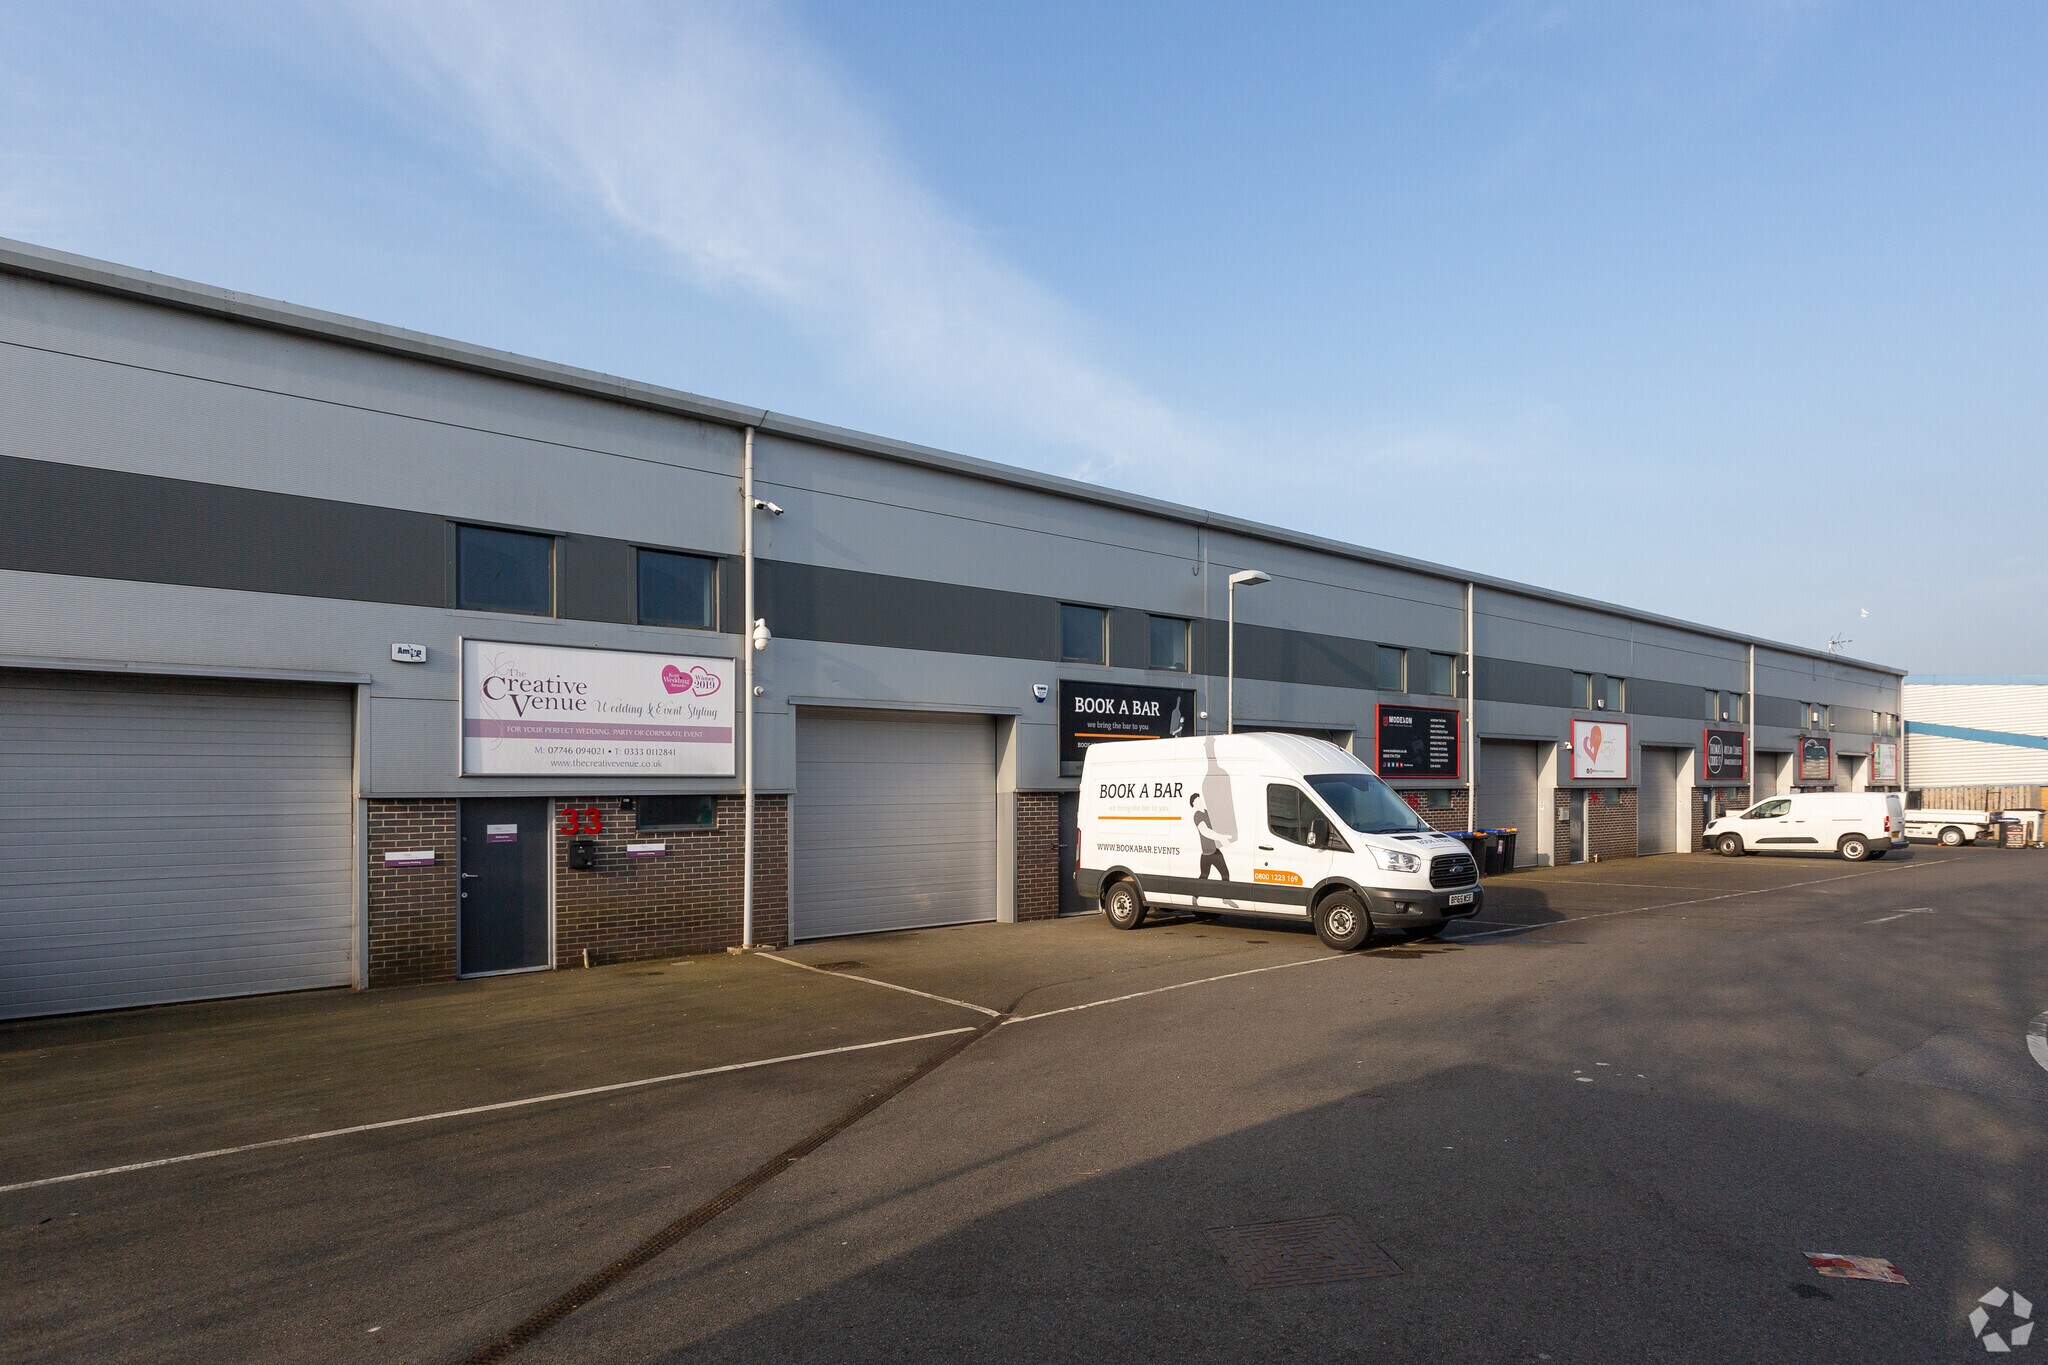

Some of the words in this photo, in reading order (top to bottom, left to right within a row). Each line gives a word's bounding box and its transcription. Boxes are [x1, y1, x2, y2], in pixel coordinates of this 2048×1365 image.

[508, 668, 527, 678] The
[482, 675, 588, 701] Creative
[694, 680, 715, 690] 2019
[508, 694, 587, 718] Venue
[592, 698, 643, 718] Wedding
[655, 702, 682, 716] Event
[687, 703, 718, 720] Styling
[1074, 696, 1115, 714] BOOK
[1118, 699, 1130, 715] A
[1132, 700, 1160, 717] BAR
[506, 725, 522, 733] FOR
[523, 726, 543, 734] YOUR
[613, 728, 633, 736] PARTY
[1096, 721, 1112, 731] bring
[1112, 721, 1122, 730] the
[1122, 722, 1132, 730] bar
[534, 746, 546, 754] M:
[547, 746, 574, 755] 07746
[575, 747, 606, 755] 094021
[624, 748, 644, 756] 0333
[646, 748, 676, 756] 0112841
[550, 759, 663, 768] www.thecreativevenue.co.uk
[1099, 783, 1136, 799] BOOK
[1138, 783, 1149, 799] A
[1153, 782, 1184, 798] BAR
[1117, 804, 1131, 813] bring
[1158, 805, 1169, 813] you
[560, 807, 603, 836] 33
[1096, 843, 1180, 856] WWW.BOOKABAR.EVENTS
[1254, 872, 1270, 880] 0800
